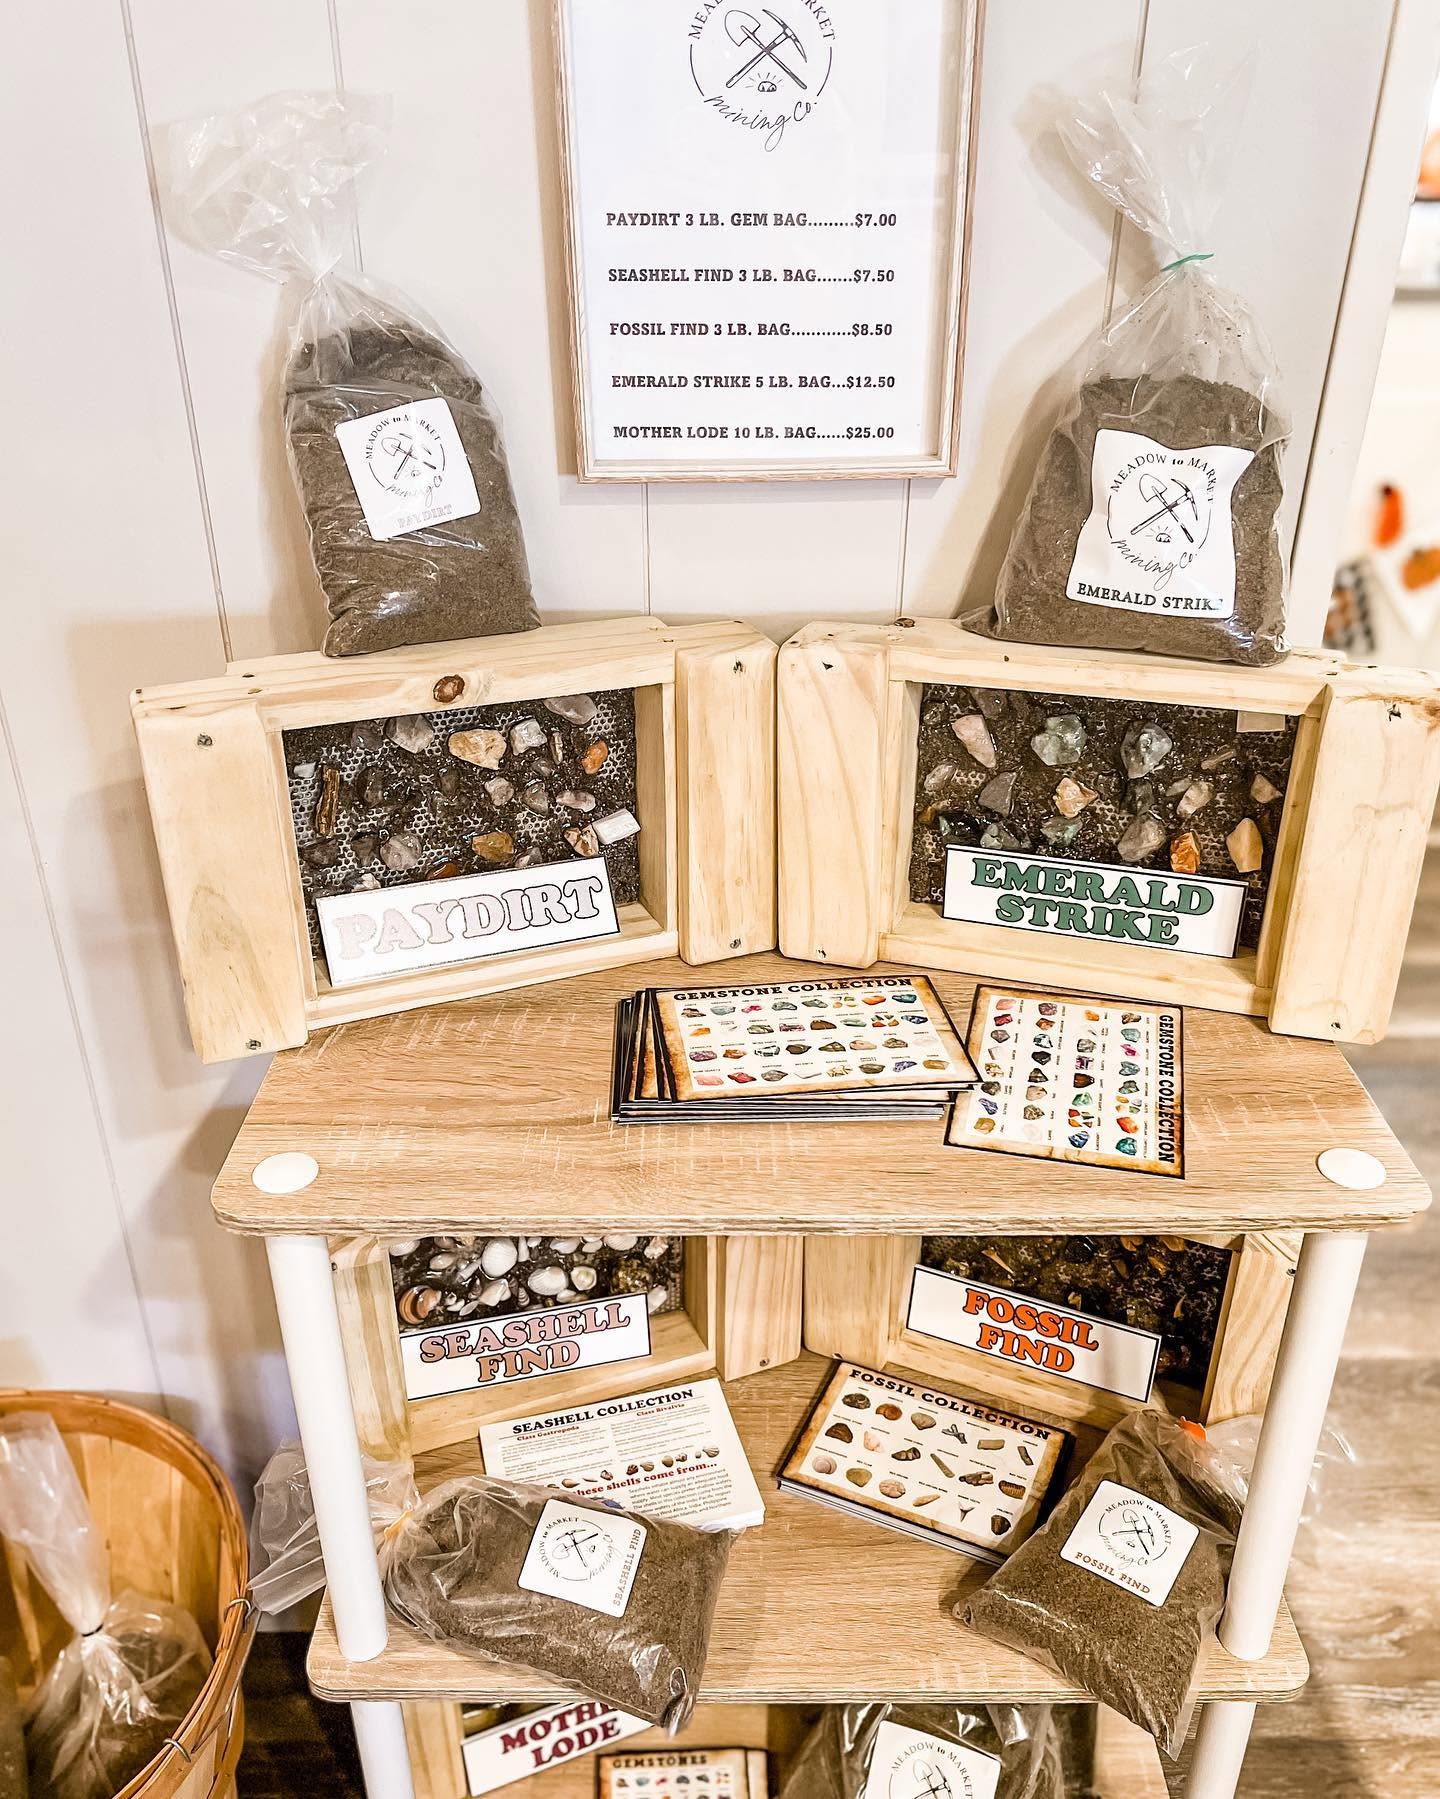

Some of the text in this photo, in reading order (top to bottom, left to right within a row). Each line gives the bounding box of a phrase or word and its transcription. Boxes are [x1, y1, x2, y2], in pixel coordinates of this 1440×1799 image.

[704, 95, 791, 152] mining
[606, 213, 680, 226] PAYDIRT
[685, 213, 694, 226] 3
[699, 213, 725, 226] LB.
[730, 213, 768, 226] GEM
[608, 268, 689, 282] SEASHELL
[694, 269, 734, 282] FIND
[738, 269, 747, 282] 3
[752, 269, 778, 282] LB.
[609, 323, 666, 336] FOSSIL
[670, 323, 709, 336] FIND
[714, 323, 722, 336] 3
[727, 323, 752, 336] LB.
[611, 375, 689, 388] EMERALD
[693, 375, 751, 388] STRIKE
[755, 376, 764, 388] 5
[768, 376, 793, 388] LB.
[365, 418, 390, 459] MEADOW
[404, 414, 441, 441] MRKET
[613, 426, 683, 439] MOTHER
[687, 426, 729, 439] LODE
[734, 427, 751, 439] 10
[755, 427, 780, 439] LB.
[385, 483, 434, 508] ming
[1110, 453, 1218, 504] MEADOW to MARKET
[397, 503, 453, 529] PAYDIRT
[1111, 539, 1178, 592] mining
[1077, 583, 1157, 606] EMERALD
[971, 857, 1215, 916] EMERALD
[332, 876, 604, 961] PAYDIRT
[996, 894, 1180, 945] STRIKE
[673, 978, 912, 1001] GEMSTONE COLLECTION
[1158, 1014, 1175, 1164] GEMSTONE COLLECTION
[420, 1303, 631, 1363] SEASHELL
[962, 1288, 1100, 1351] FOSSIL
[476, 1340, 581, 1382] FIND
[976, 1322, 1075, 1373] FIND
[512, 1389, 694, 1434] SEASHELL COLLECTION
[636, 1408, 655, 1417] Class
[850, 1369, 1051, 1440] FOSSIL COLLECTION
[516, 1433, 536, 1441] Class
[574, 1462, 718, 1496] hese shells come from...
[546, 1516, 579, 1529] MARKET
[1104, 1499, 1145, 1514] MEADOW
[1155, 1510, 1172, 1546] MARKET
[613, 1528, 642, 1606] SEASHELL FIND
[1074, 1551, 1151, 1594] FOSSIL FIND
[500, 1702, 617, 1755] MOTH
[531, 1717, 622, 1768] LODE
[612, 1754, 708, 1769] GEMSTONES
[891, 1741, 973, 1799] MEADOW to MARKET
